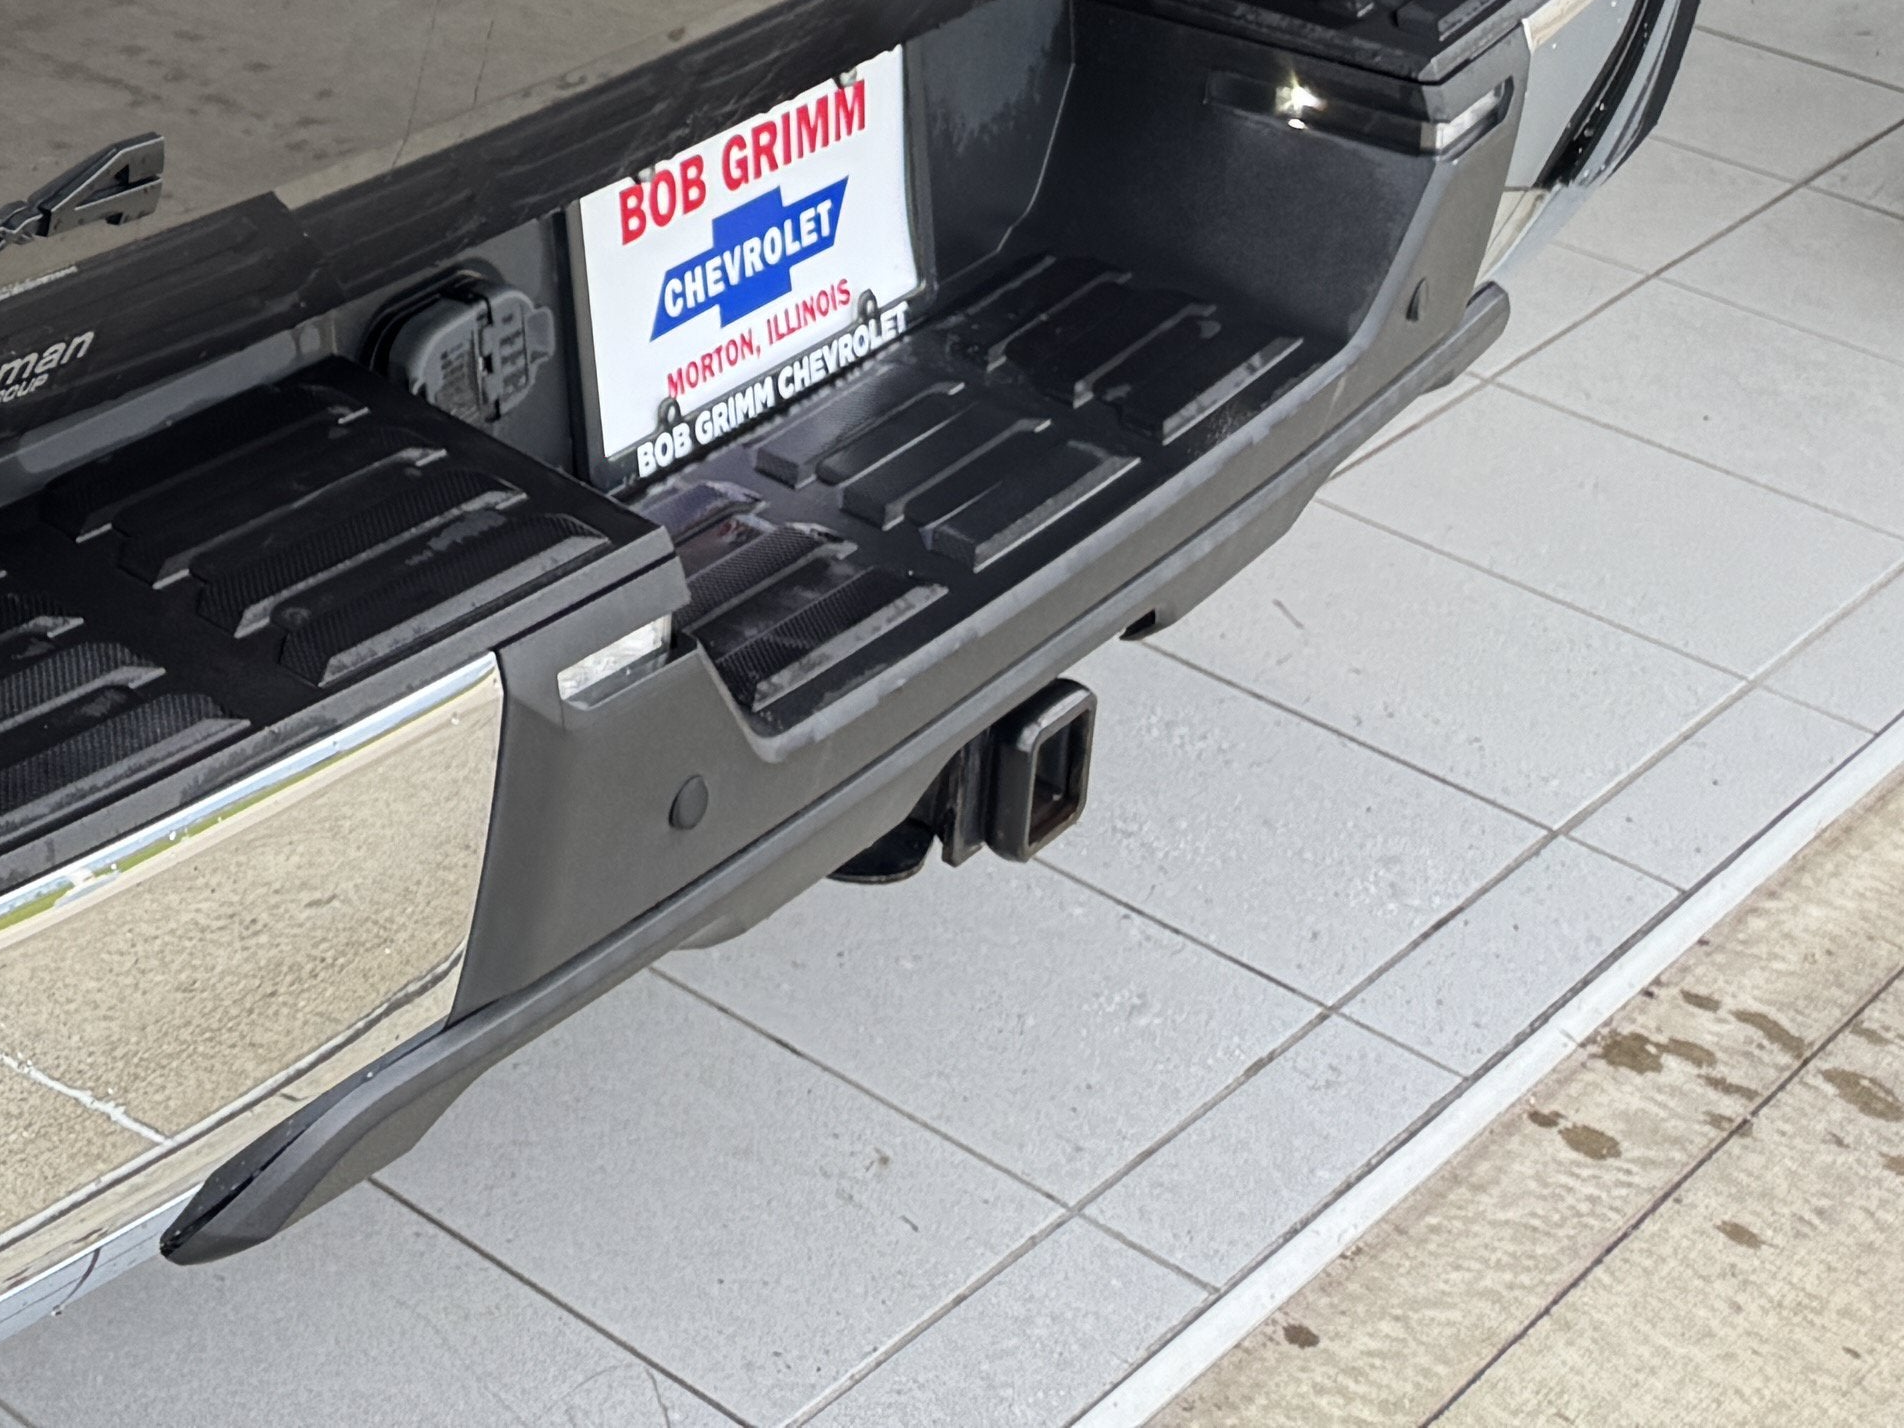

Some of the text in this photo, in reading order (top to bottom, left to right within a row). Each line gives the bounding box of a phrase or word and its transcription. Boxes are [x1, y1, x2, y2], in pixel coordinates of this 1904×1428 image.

[618, 79, 867, 246] BOB GRIMM
[662, 199, 835, 319] CHEVROLET
[636, 300, 911, 479] BOB GRIMM CHEVROLET
[665, 277, 852, 400] MORTON, ILLINOIS
